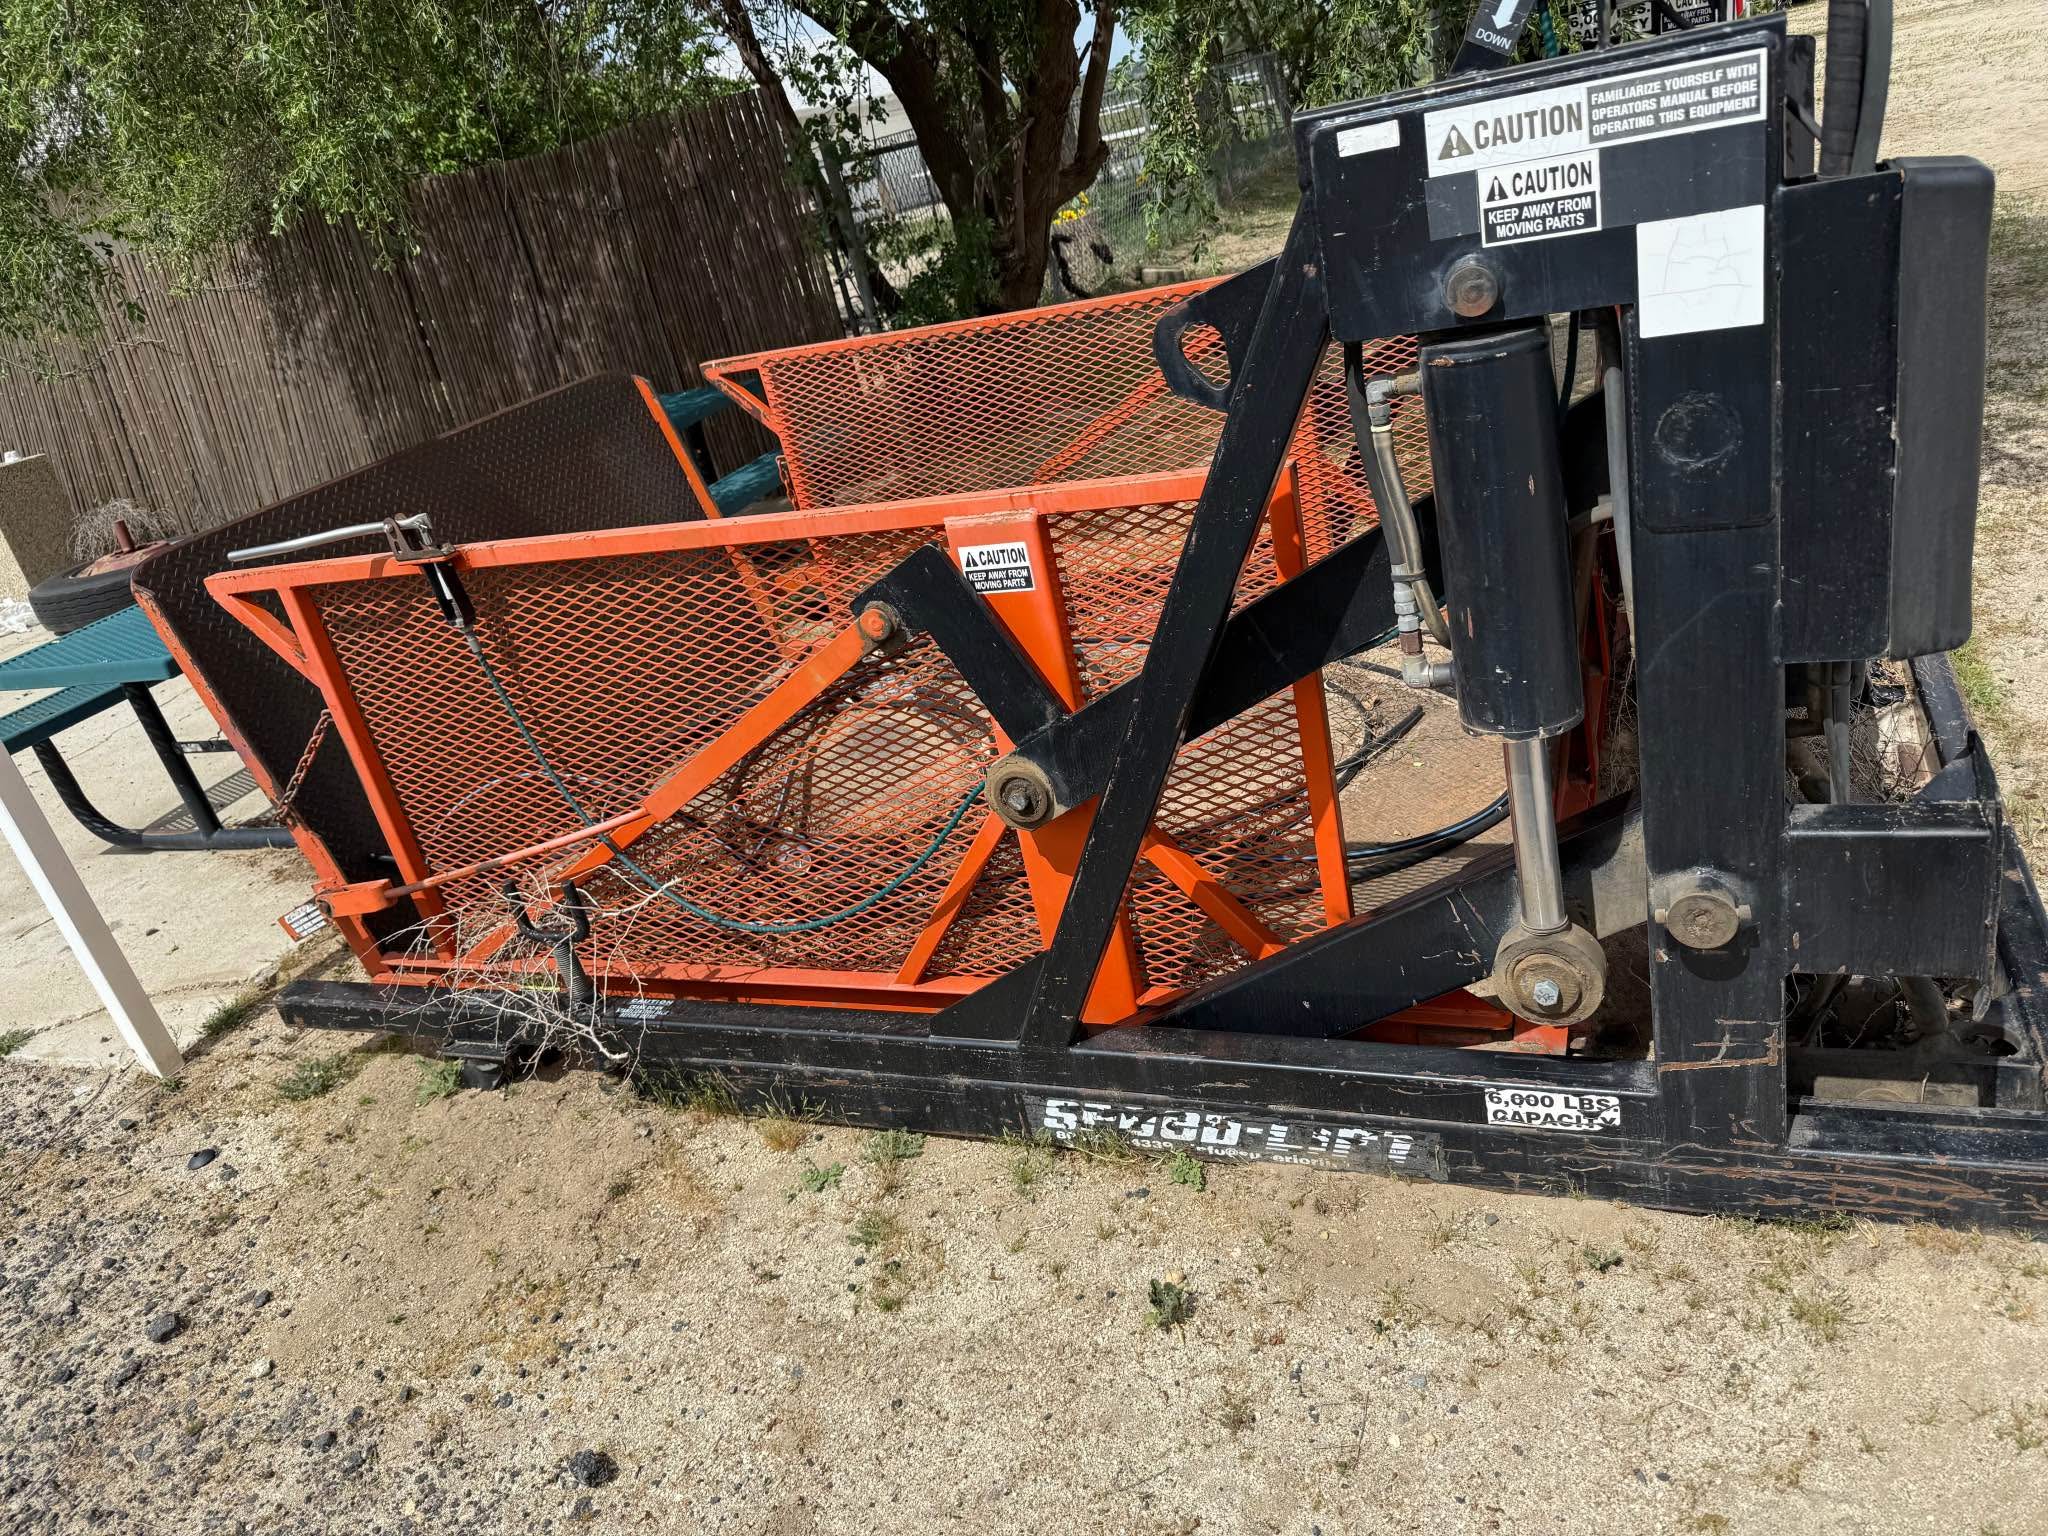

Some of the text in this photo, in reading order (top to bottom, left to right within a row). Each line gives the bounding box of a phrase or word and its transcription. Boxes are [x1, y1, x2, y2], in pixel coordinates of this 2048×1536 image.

[1690, 15, 1711, 24] PARTS
[1475, 27, 1512, 50] DOWN
[1591, 62, 1758, 106] FAMILIARIZE YOURSELF WITH
[1591, 79, 1758, 121] OPERATORS MANUAL BEFORE
[1474, 101, 1583, 150] CAUTION
[1592, 95, 1757, 137] OPERATING THIS EQUIPMENT
[1512, 160, 1592, 197] CAUTION
[1488, 195, 1592, 225] KEEP AWAY FROM
[1496, 212, 1585, 239] MOVING PARTS
[978, 547, 1027, 566] CAUTION
[968, 568, 1029, 582] KEEP AWAY FROM
[974, 578, 1026, 590] MOVING PARTS
[1487, 1090, 1619, 1113] 6,000 LBS.
[1492, 1108, 1618, 1129] CAPACITY
